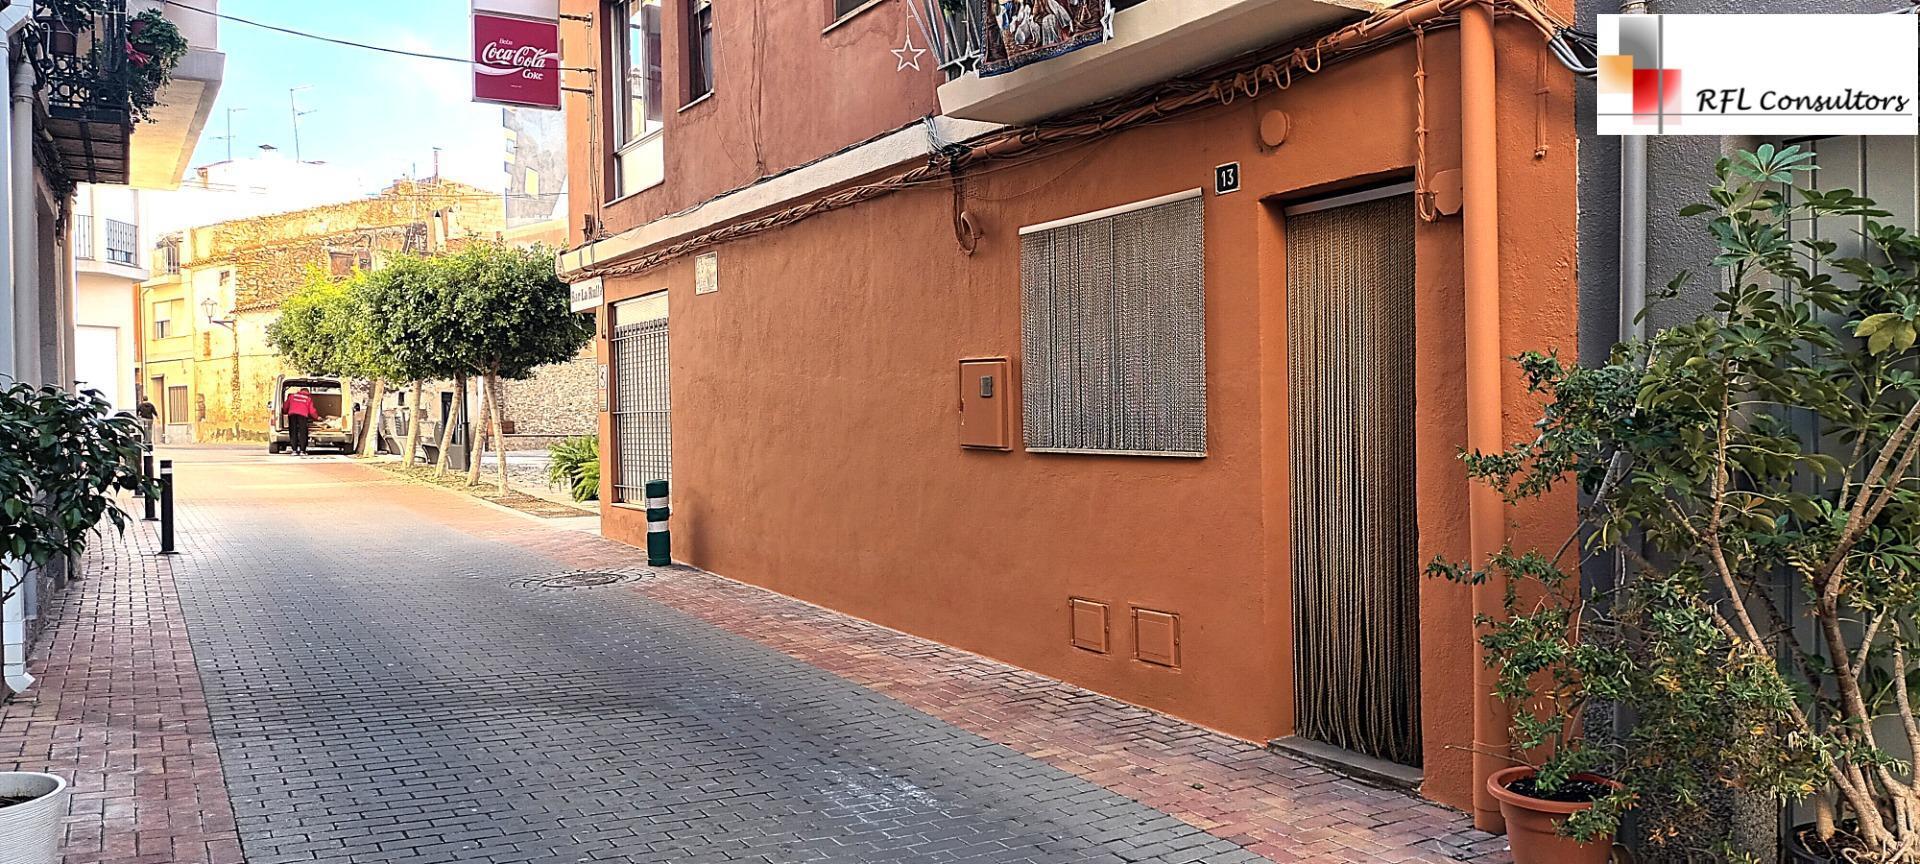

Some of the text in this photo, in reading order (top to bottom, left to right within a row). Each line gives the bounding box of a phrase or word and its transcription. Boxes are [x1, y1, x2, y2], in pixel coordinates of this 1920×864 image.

[482, 41, 547, 68] Coca-Cola
[522, 69, 544, 80] Coke
[1221, 168, 1234, 187] 13
[571, 291, 581, 303] Bar
[581, 289, 588, 301] La
